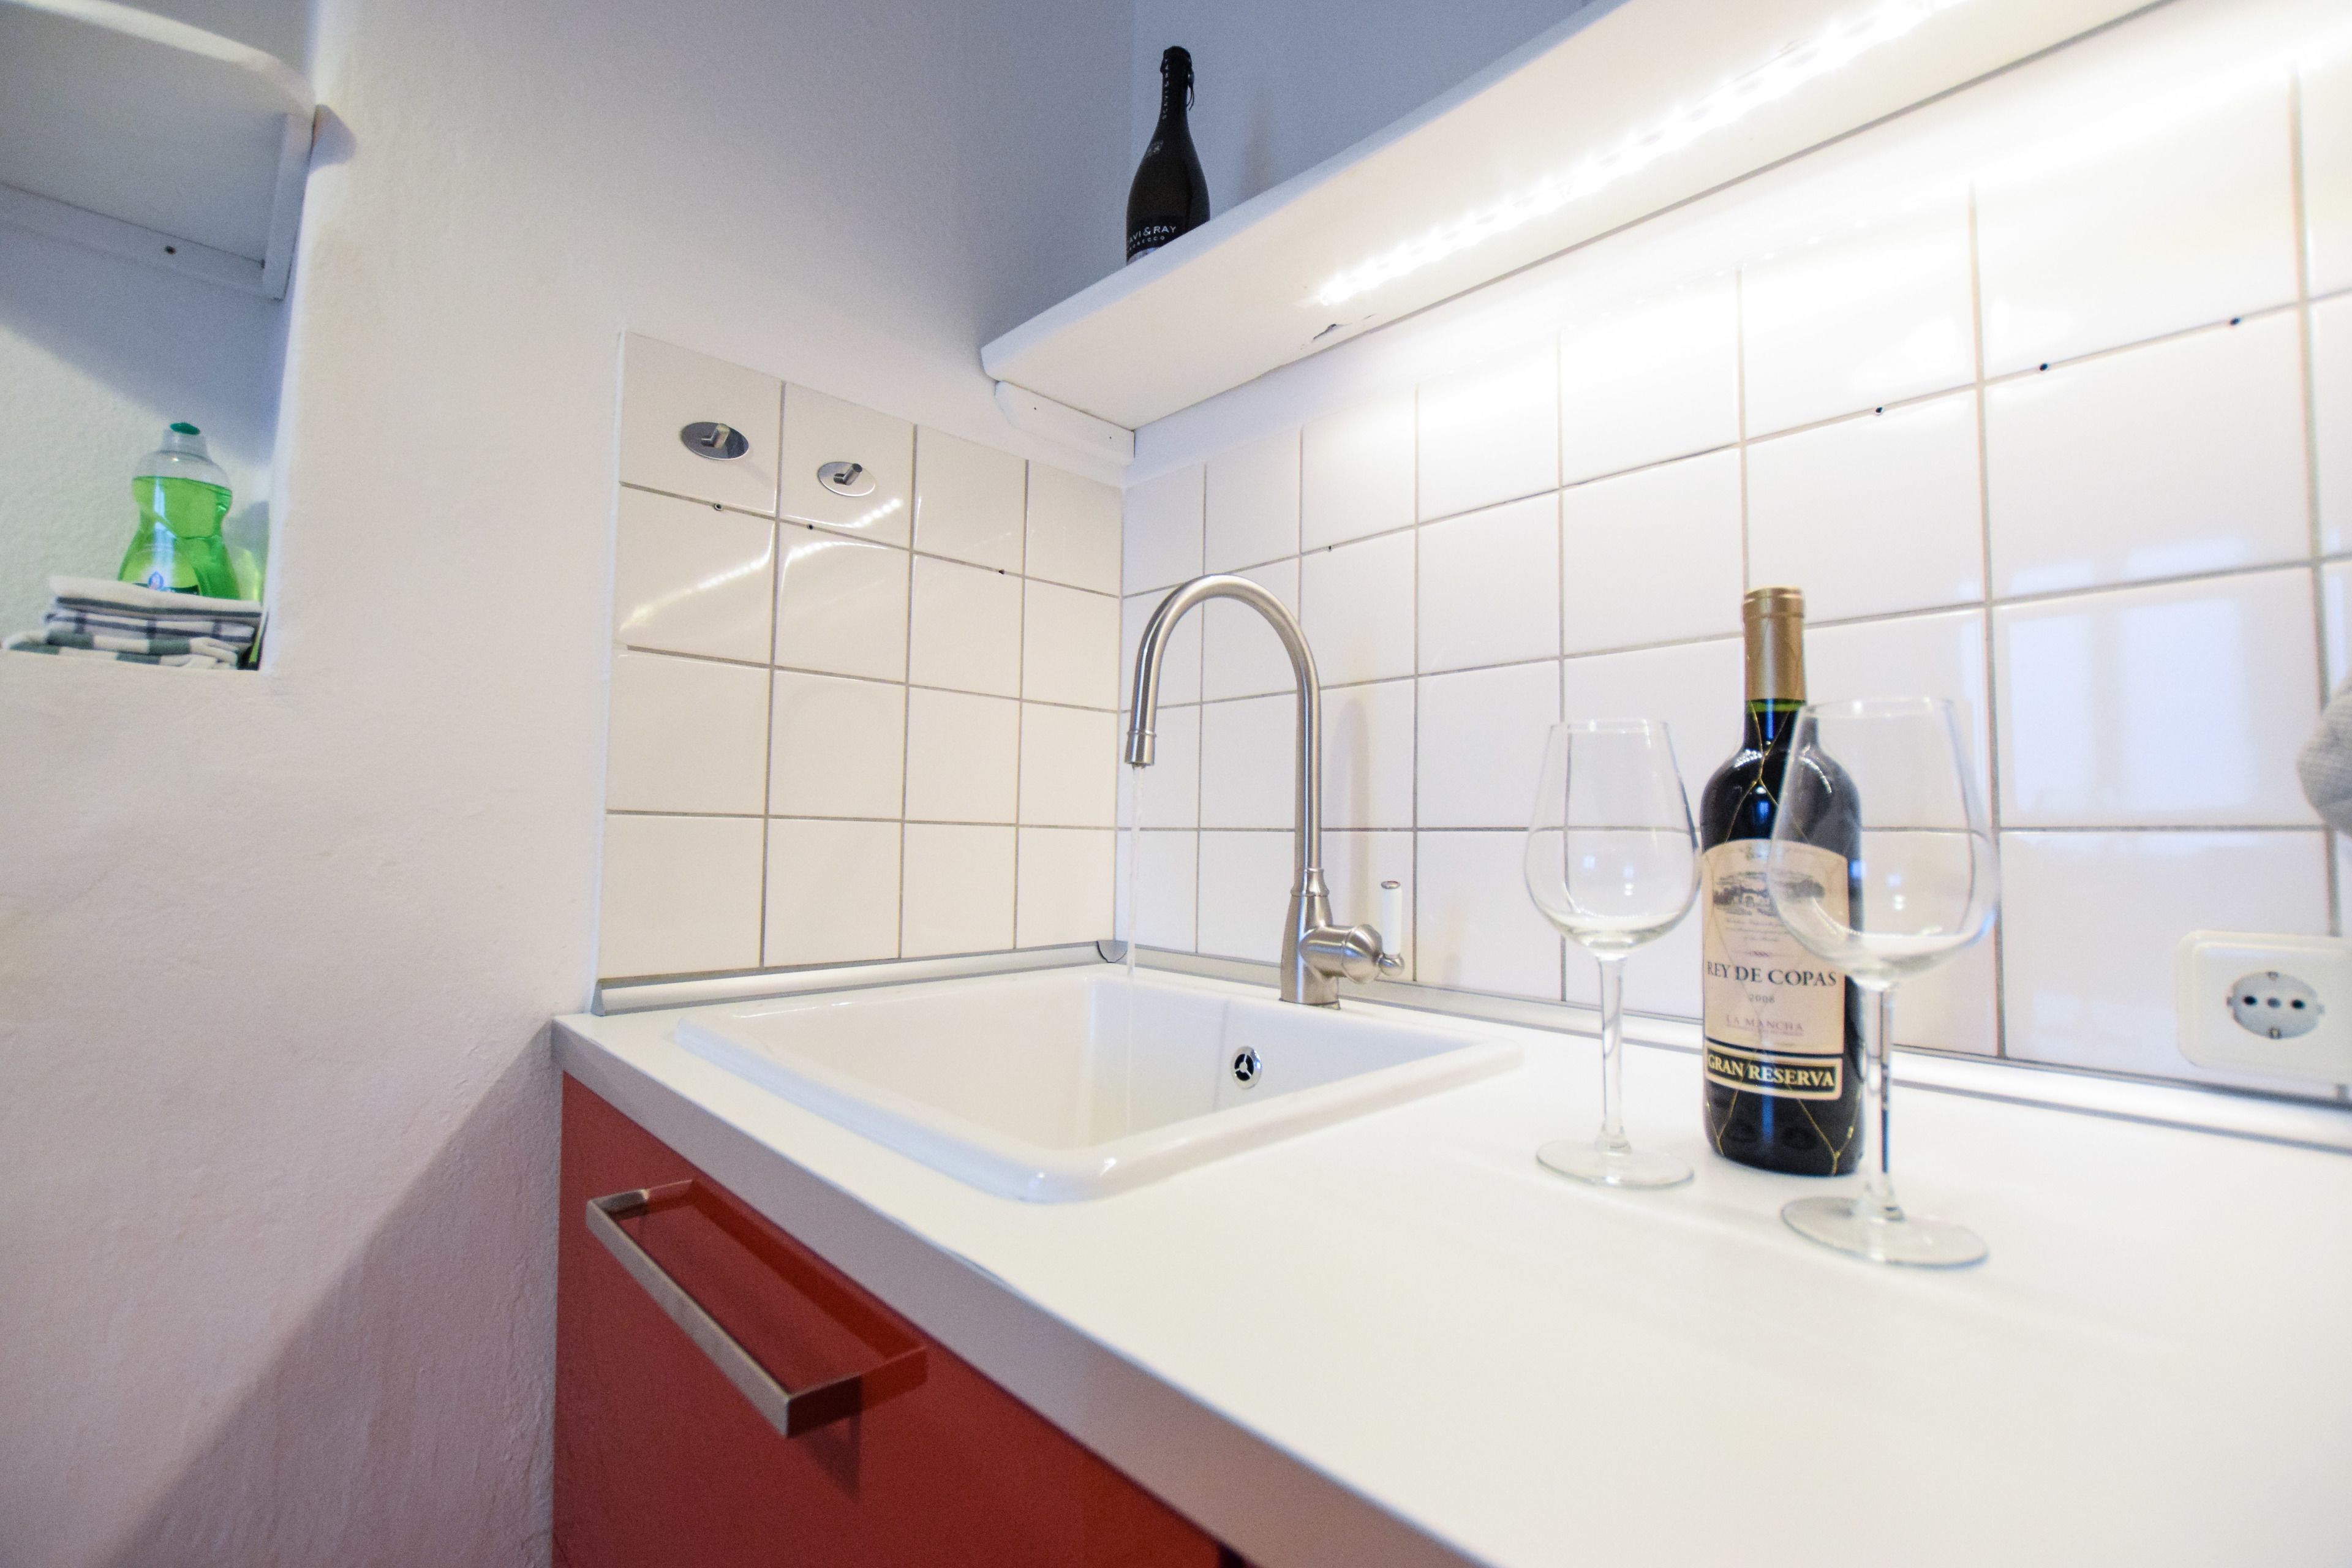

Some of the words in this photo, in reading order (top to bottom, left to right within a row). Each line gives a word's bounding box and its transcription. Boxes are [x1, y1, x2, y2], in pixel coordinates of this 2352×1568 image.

[1707, 960, 1731, 979] REY
[1735, 965, 1763, 983] DE
[1768, 969, 1837, 987] COPAS
[1726, 1014, 1740, 1025] LA
[1744, 1018, 1804, 1031] MANCHA
[1708, 1054, 1745, 1077] GRAN
[1749, 1065, 1834, 1087] RESERVA
